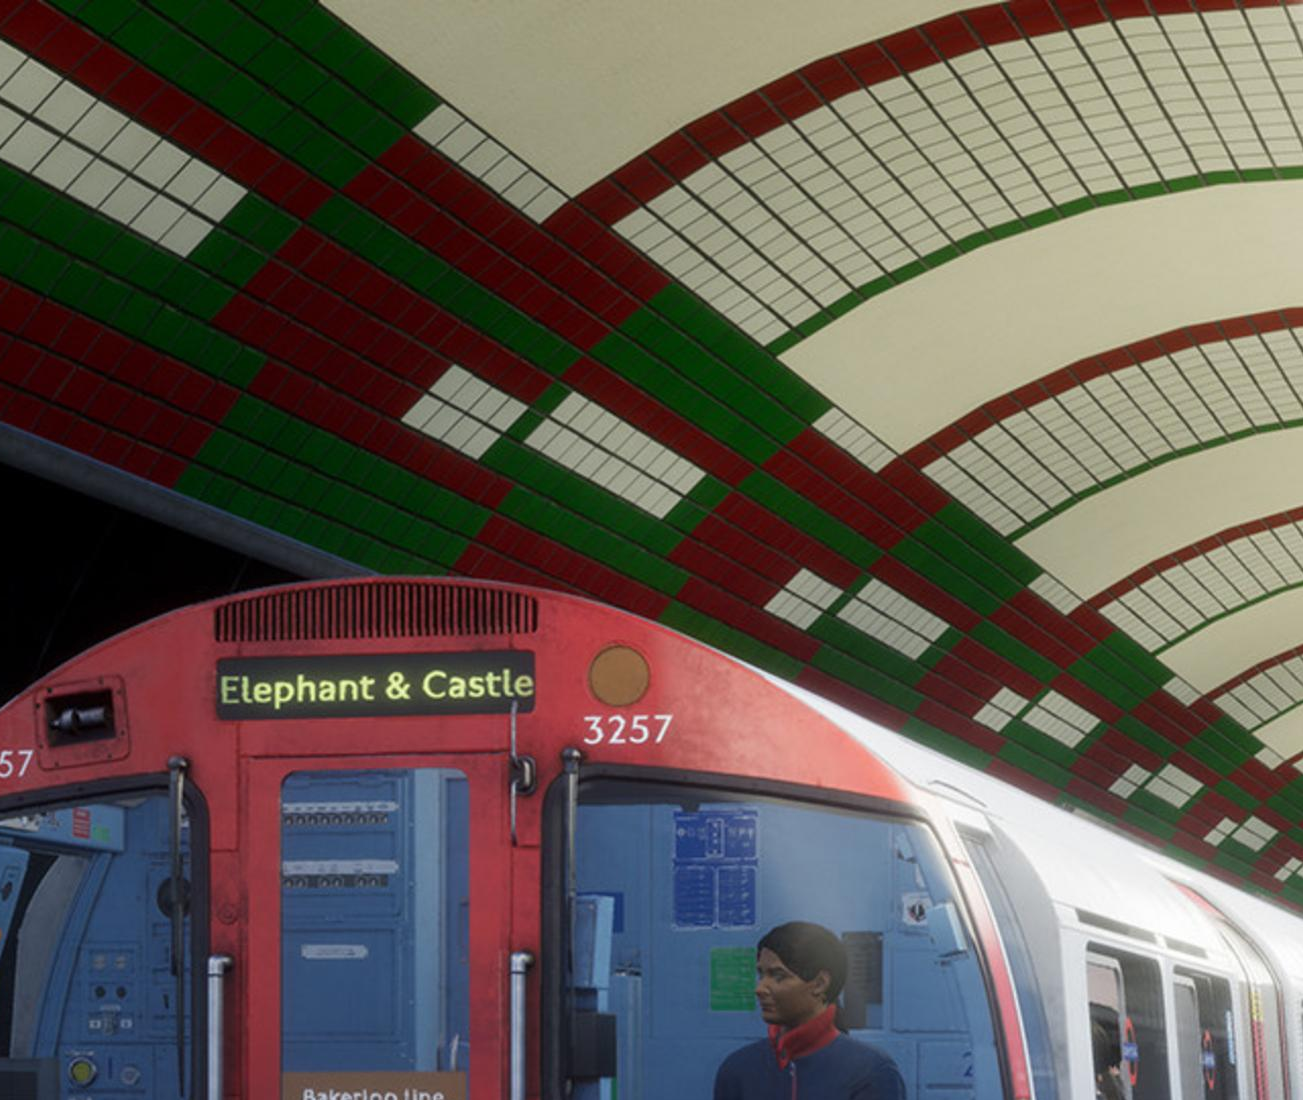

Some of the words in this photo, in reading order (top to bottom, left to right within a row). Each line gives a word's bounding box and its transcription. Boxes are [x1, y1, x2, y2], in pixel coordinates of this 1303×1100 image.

[221, 674, 375, 710] Elephant
[385, 671, 411, 700] &
[422, 668, 534, 699] Castle
[583, 714, 674, 744] 3257
